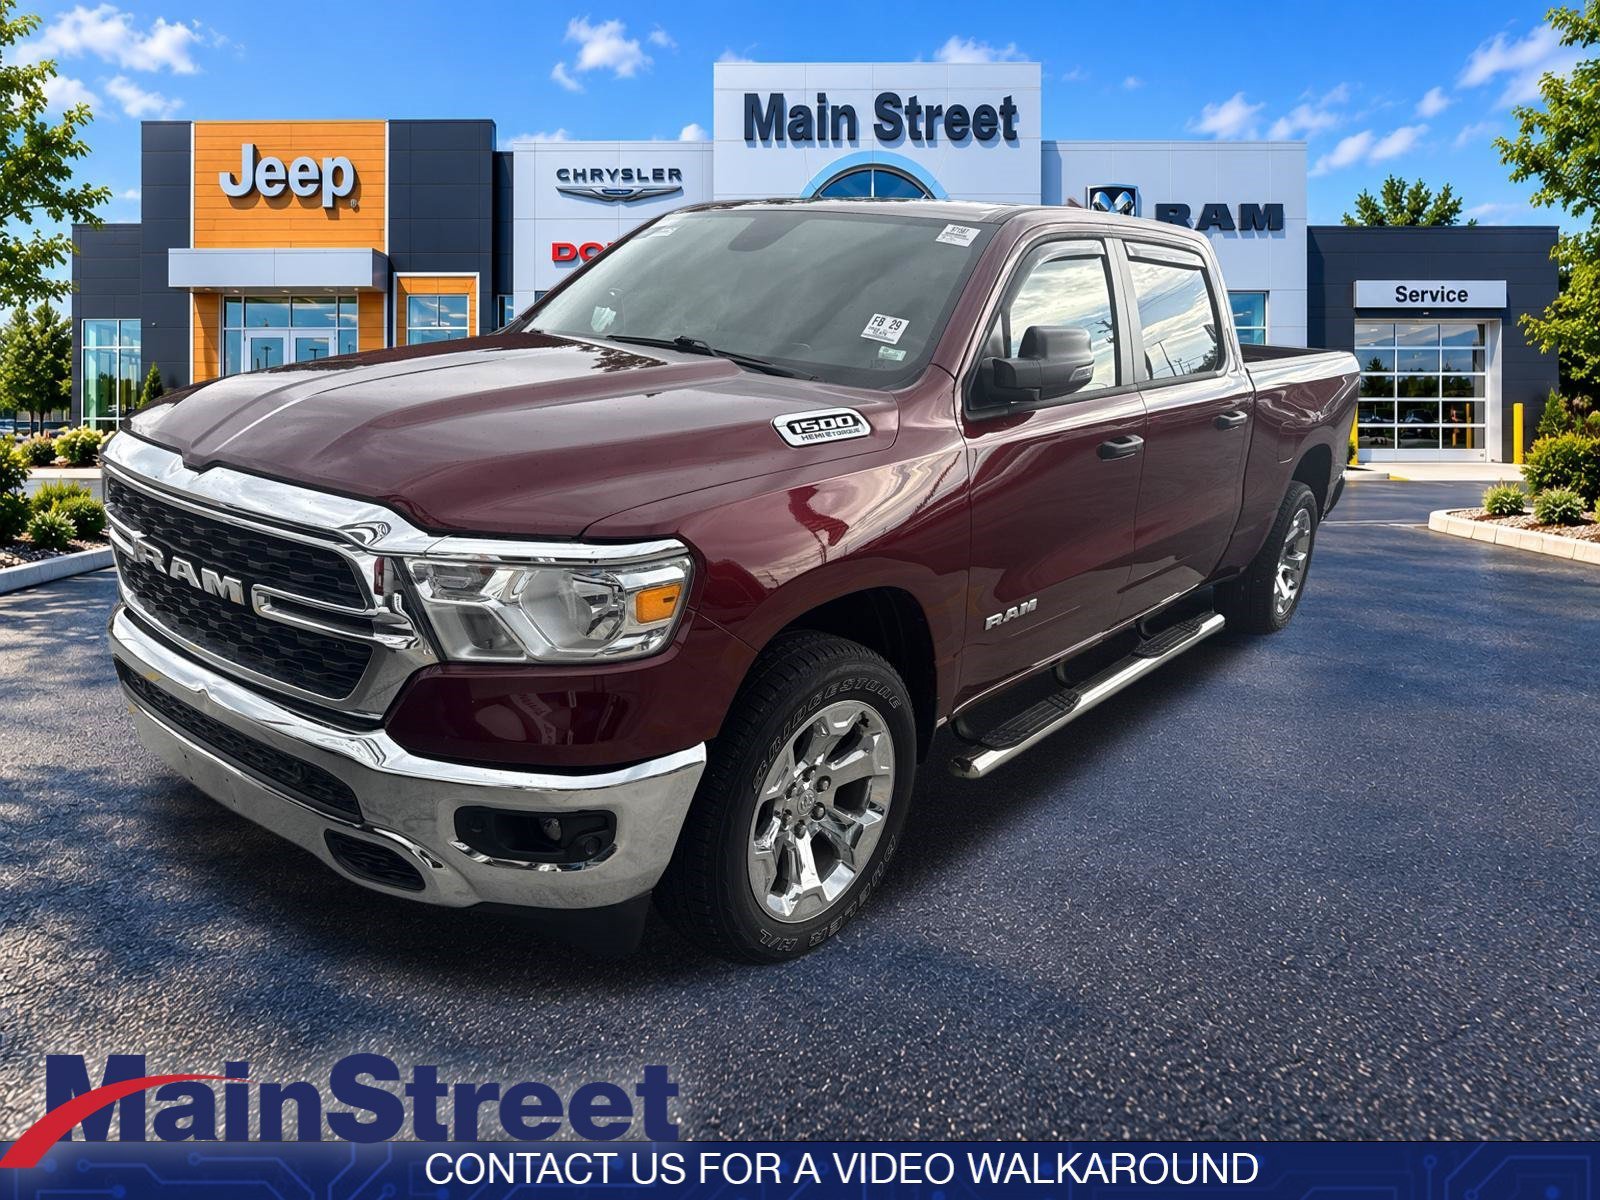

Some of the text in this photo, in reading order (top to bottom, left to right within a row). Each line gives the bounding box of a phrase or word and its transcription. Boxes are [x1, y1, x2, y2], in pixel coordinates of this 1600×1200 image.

[743, 91, 1019, 141] Main Street
[218, 143, 355, 208] Jeep
[556, 168, 682, 182] CHRYSLER
[1154, 203, 1284, 231] RAM
[551, 241, 617, 263] DO
[1395, 285, 1469, 303] Service
[871, 316, 903, 331] FB 29
[790, 416, 855, 434] 1500
[800, 432, 826, 441] HEMI
[134, 539, 246, 606] RAM
[985, 598, 1038, 631] RAM
